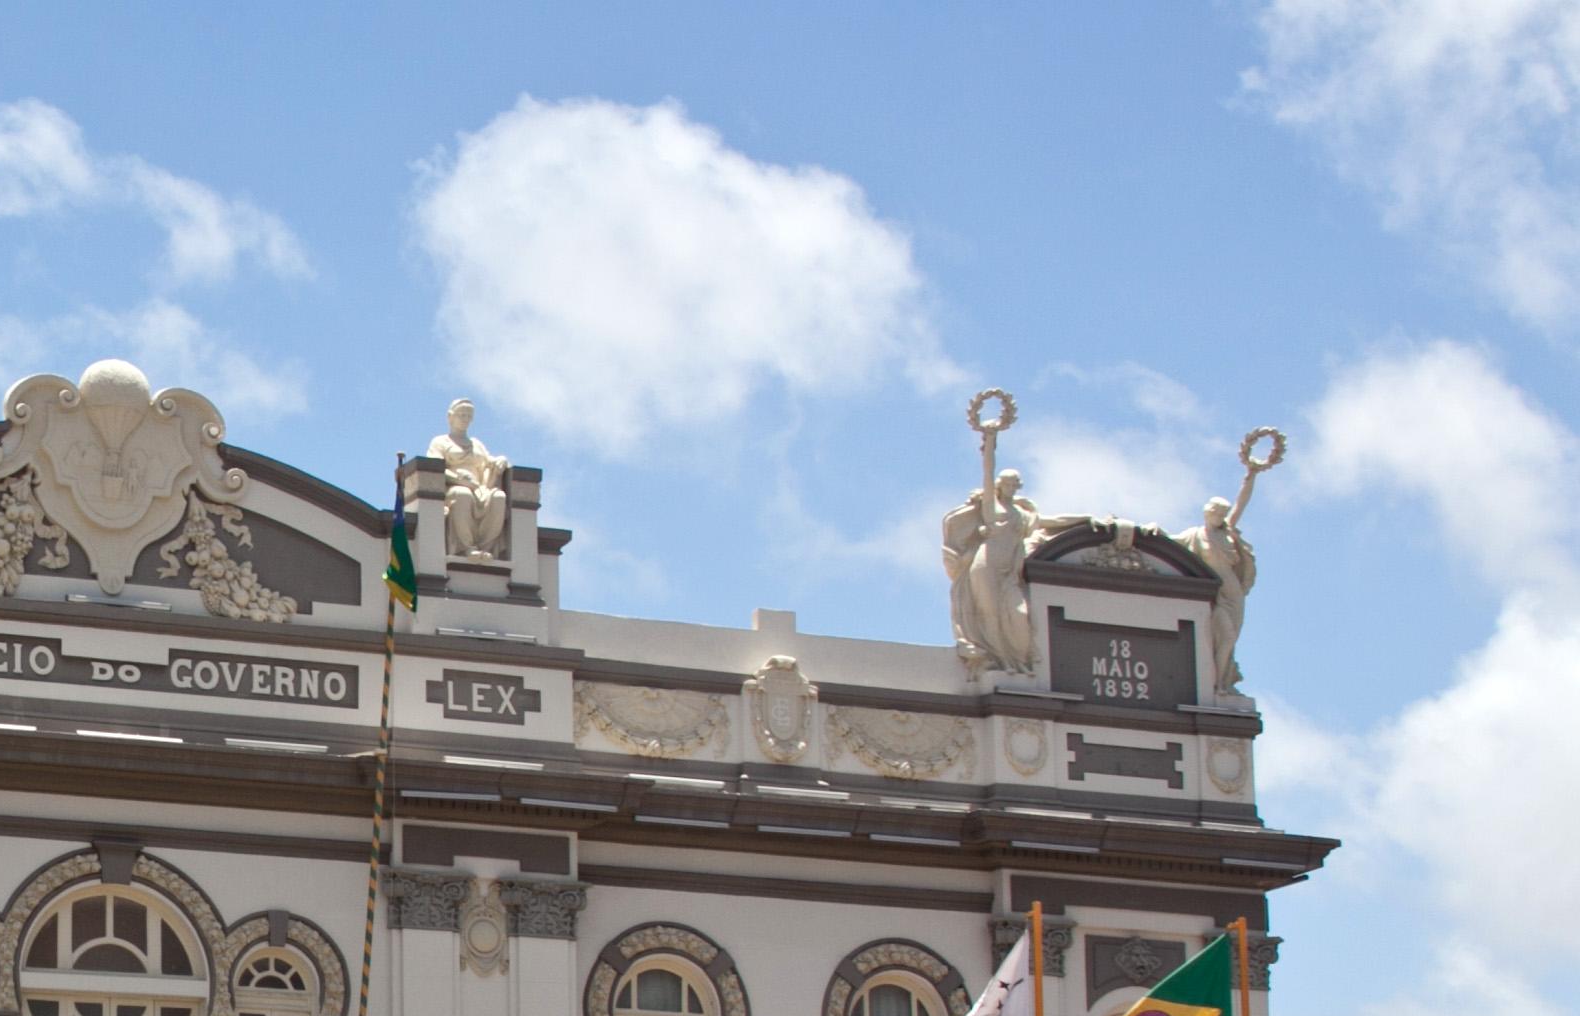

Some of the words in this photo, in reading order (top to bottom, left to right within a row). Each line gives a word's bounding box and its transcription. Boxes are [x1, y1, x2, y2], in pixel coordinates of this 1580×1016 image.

[1109, 639, 1132, 659] 18
[91, 661, 141, 683] DO
[170, 658, 347, 701] GOVERNO
[1092, 656, 1149, 680] MAIO
[447, 680, 517, 716] LEX
[1092, 677, 1149, 700] 1892
